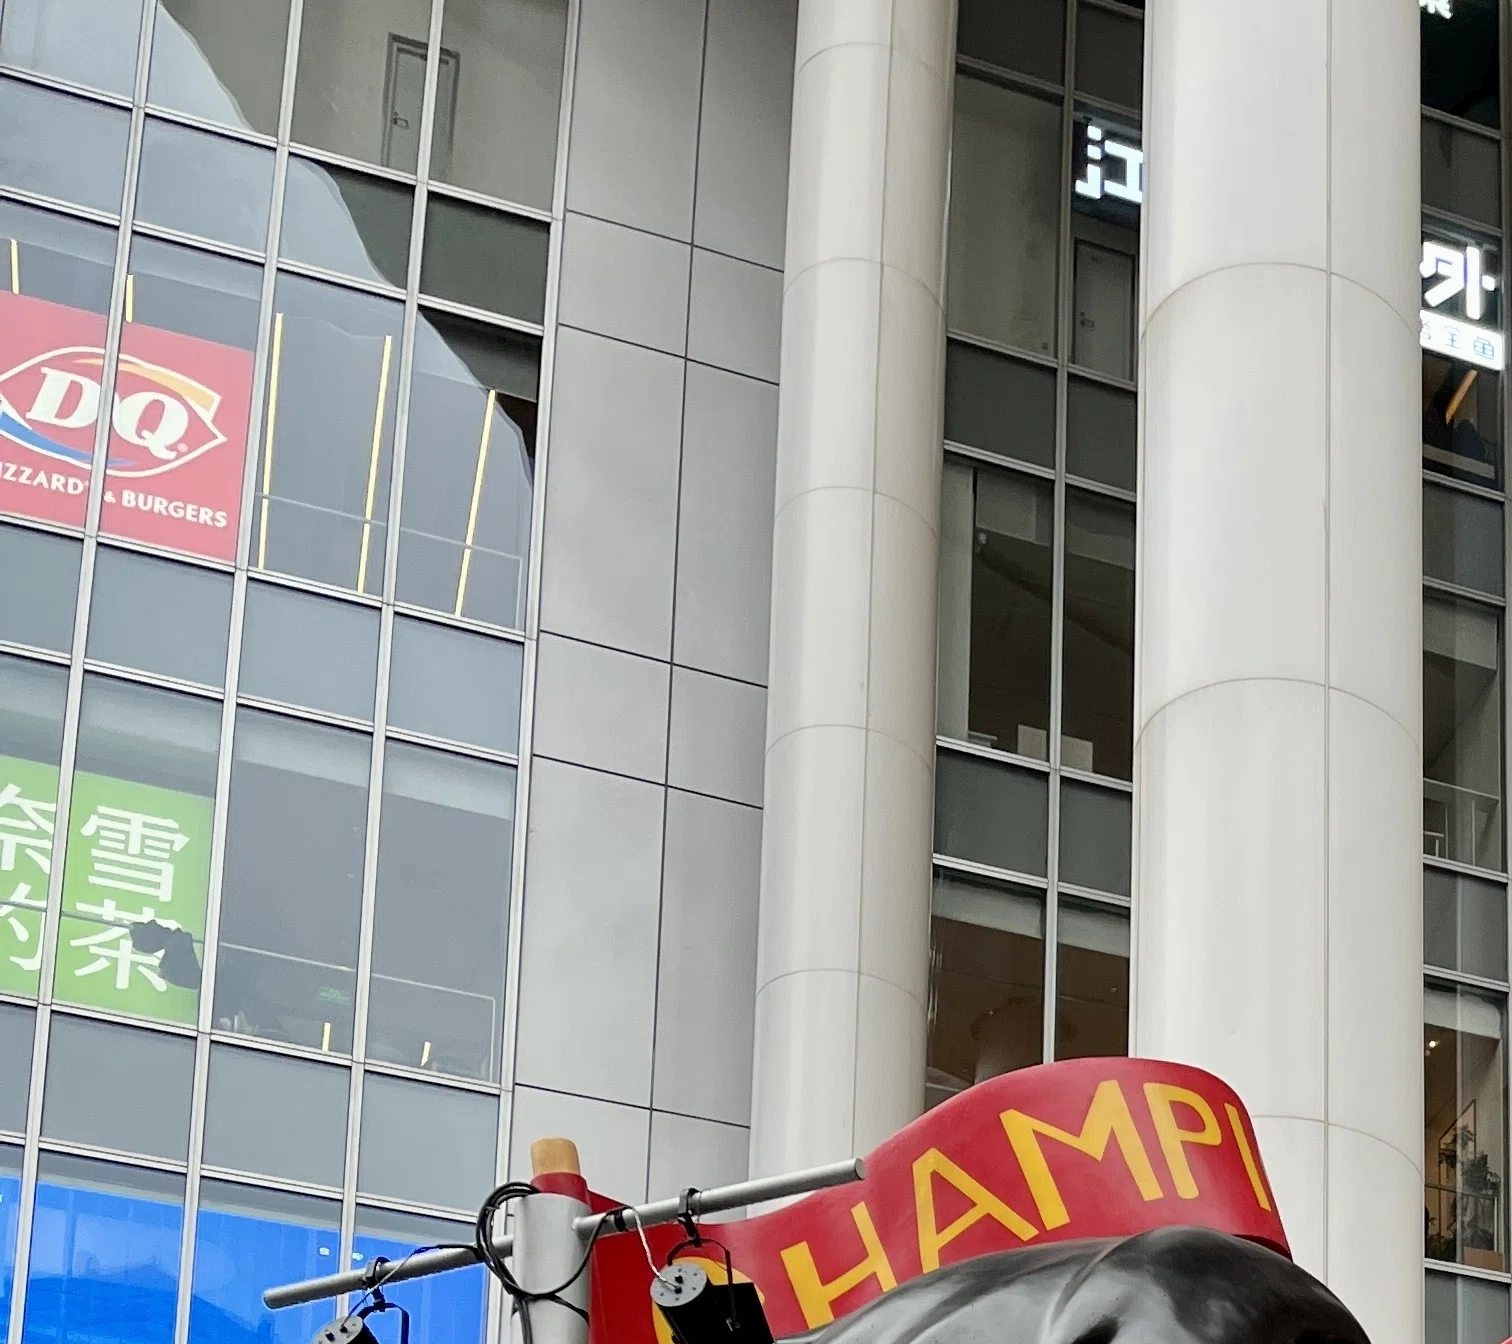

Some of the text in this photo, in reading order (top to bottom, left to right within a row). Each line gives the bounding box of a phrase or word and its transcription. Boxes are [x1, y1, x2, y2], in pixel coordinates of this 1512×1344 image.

[25, 367, 189, 460] DQ
[103, 490, 117, 504] &
[121, 489, 228, 528] BURGERS
